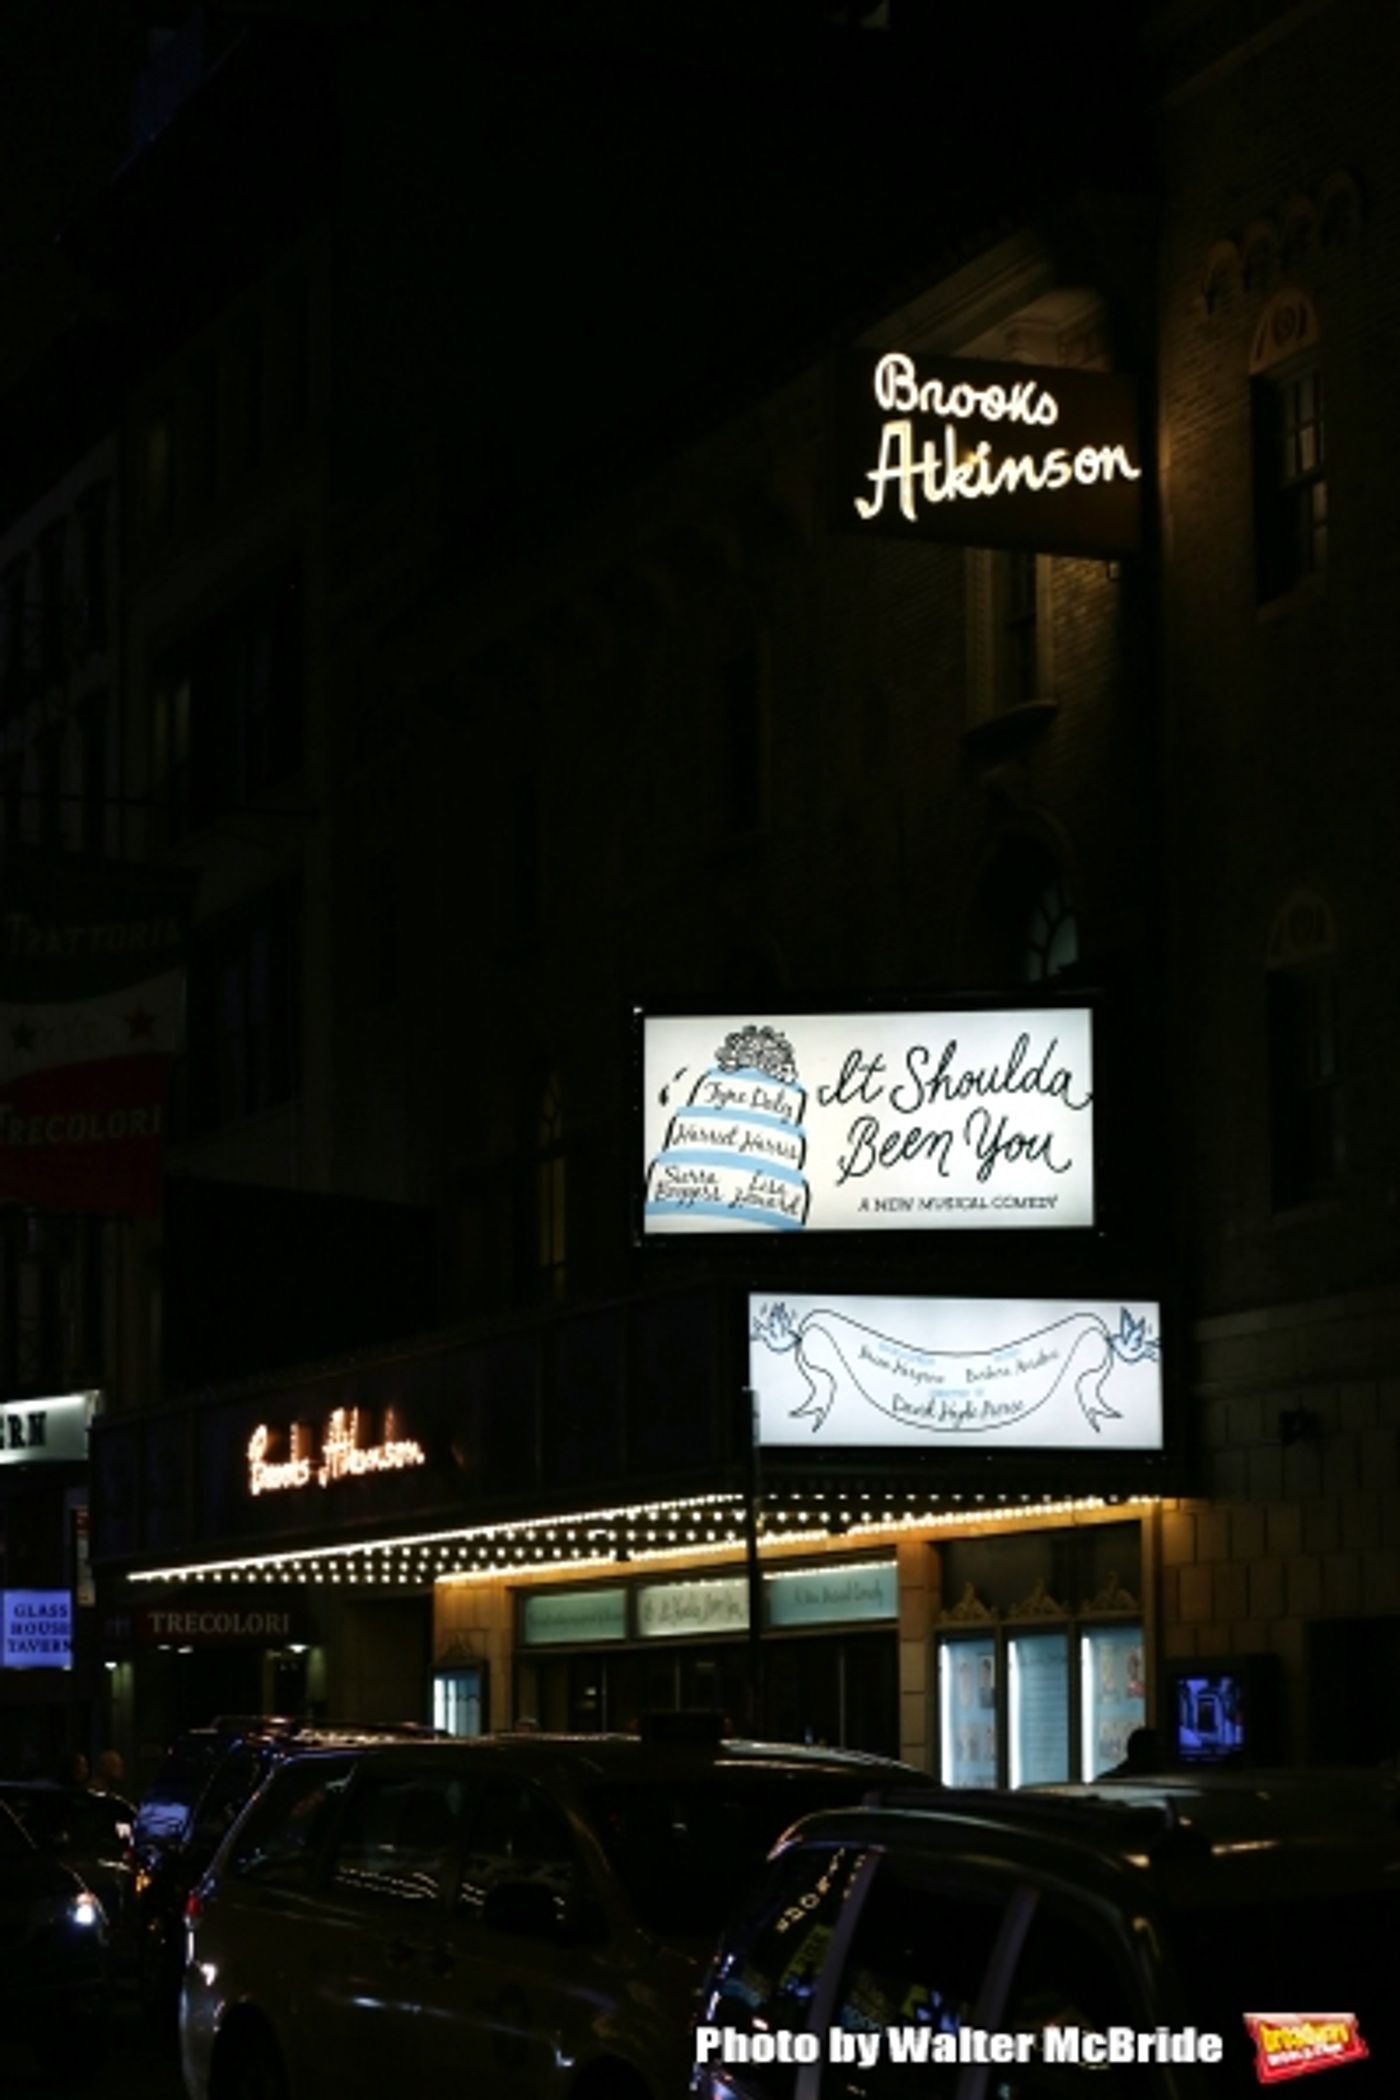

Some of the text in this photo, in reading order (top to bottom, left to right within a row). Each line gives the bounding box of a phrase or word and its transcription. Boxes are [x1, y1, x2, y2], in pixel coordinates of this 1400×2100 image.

[873, 351, 1059, 426] Brooks
[854, 418, 1142, 522] Atkinson
[817, 1032, 1095, 1114] It Shoulda
[705, 1082, 793, 1124] Tyne Daly
[836, 1106, 1073, 1187] Been You
[858, 1196, 870, 1212] A
[919, 1195, 988, 1211] MUSICAL
[991, 1194, 1059, 1210] COMEDY
[0, 1411, 47, 1450] RN
[14, 1604, 68, 1618] GLASS
[147, 1609, 290, 1636] TRECOLORI
[7, 1638, 71, 1654] TAVERN
